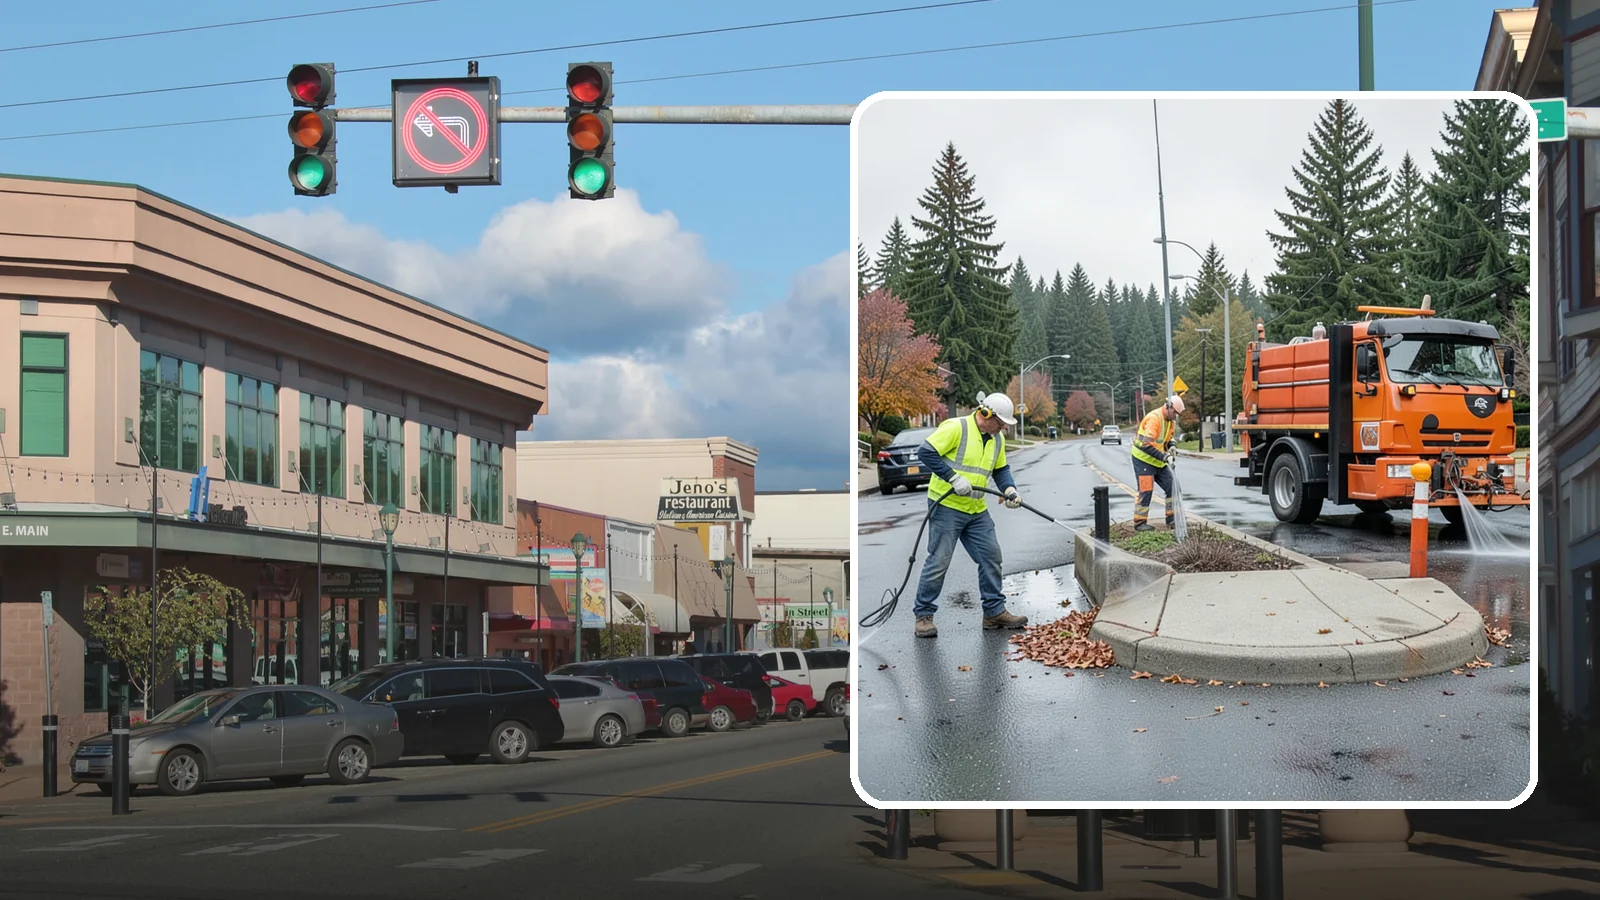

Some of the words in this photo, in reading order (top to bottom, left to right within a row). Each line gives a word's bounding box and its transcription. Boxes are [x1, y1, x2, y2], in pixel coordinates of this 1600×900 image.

[669, 479, 728, 495] Jeno's
[664, 496, 731, 509] restaurant
[685, 509, 714, 519] American
[714, 509, 738, 519] Cuisine
[2, 525, 13, 536] E.
[15, 525, 49, 536] MAIN
[797, 607, 829, 617] Street
[790, 619, 823, 627] lass
